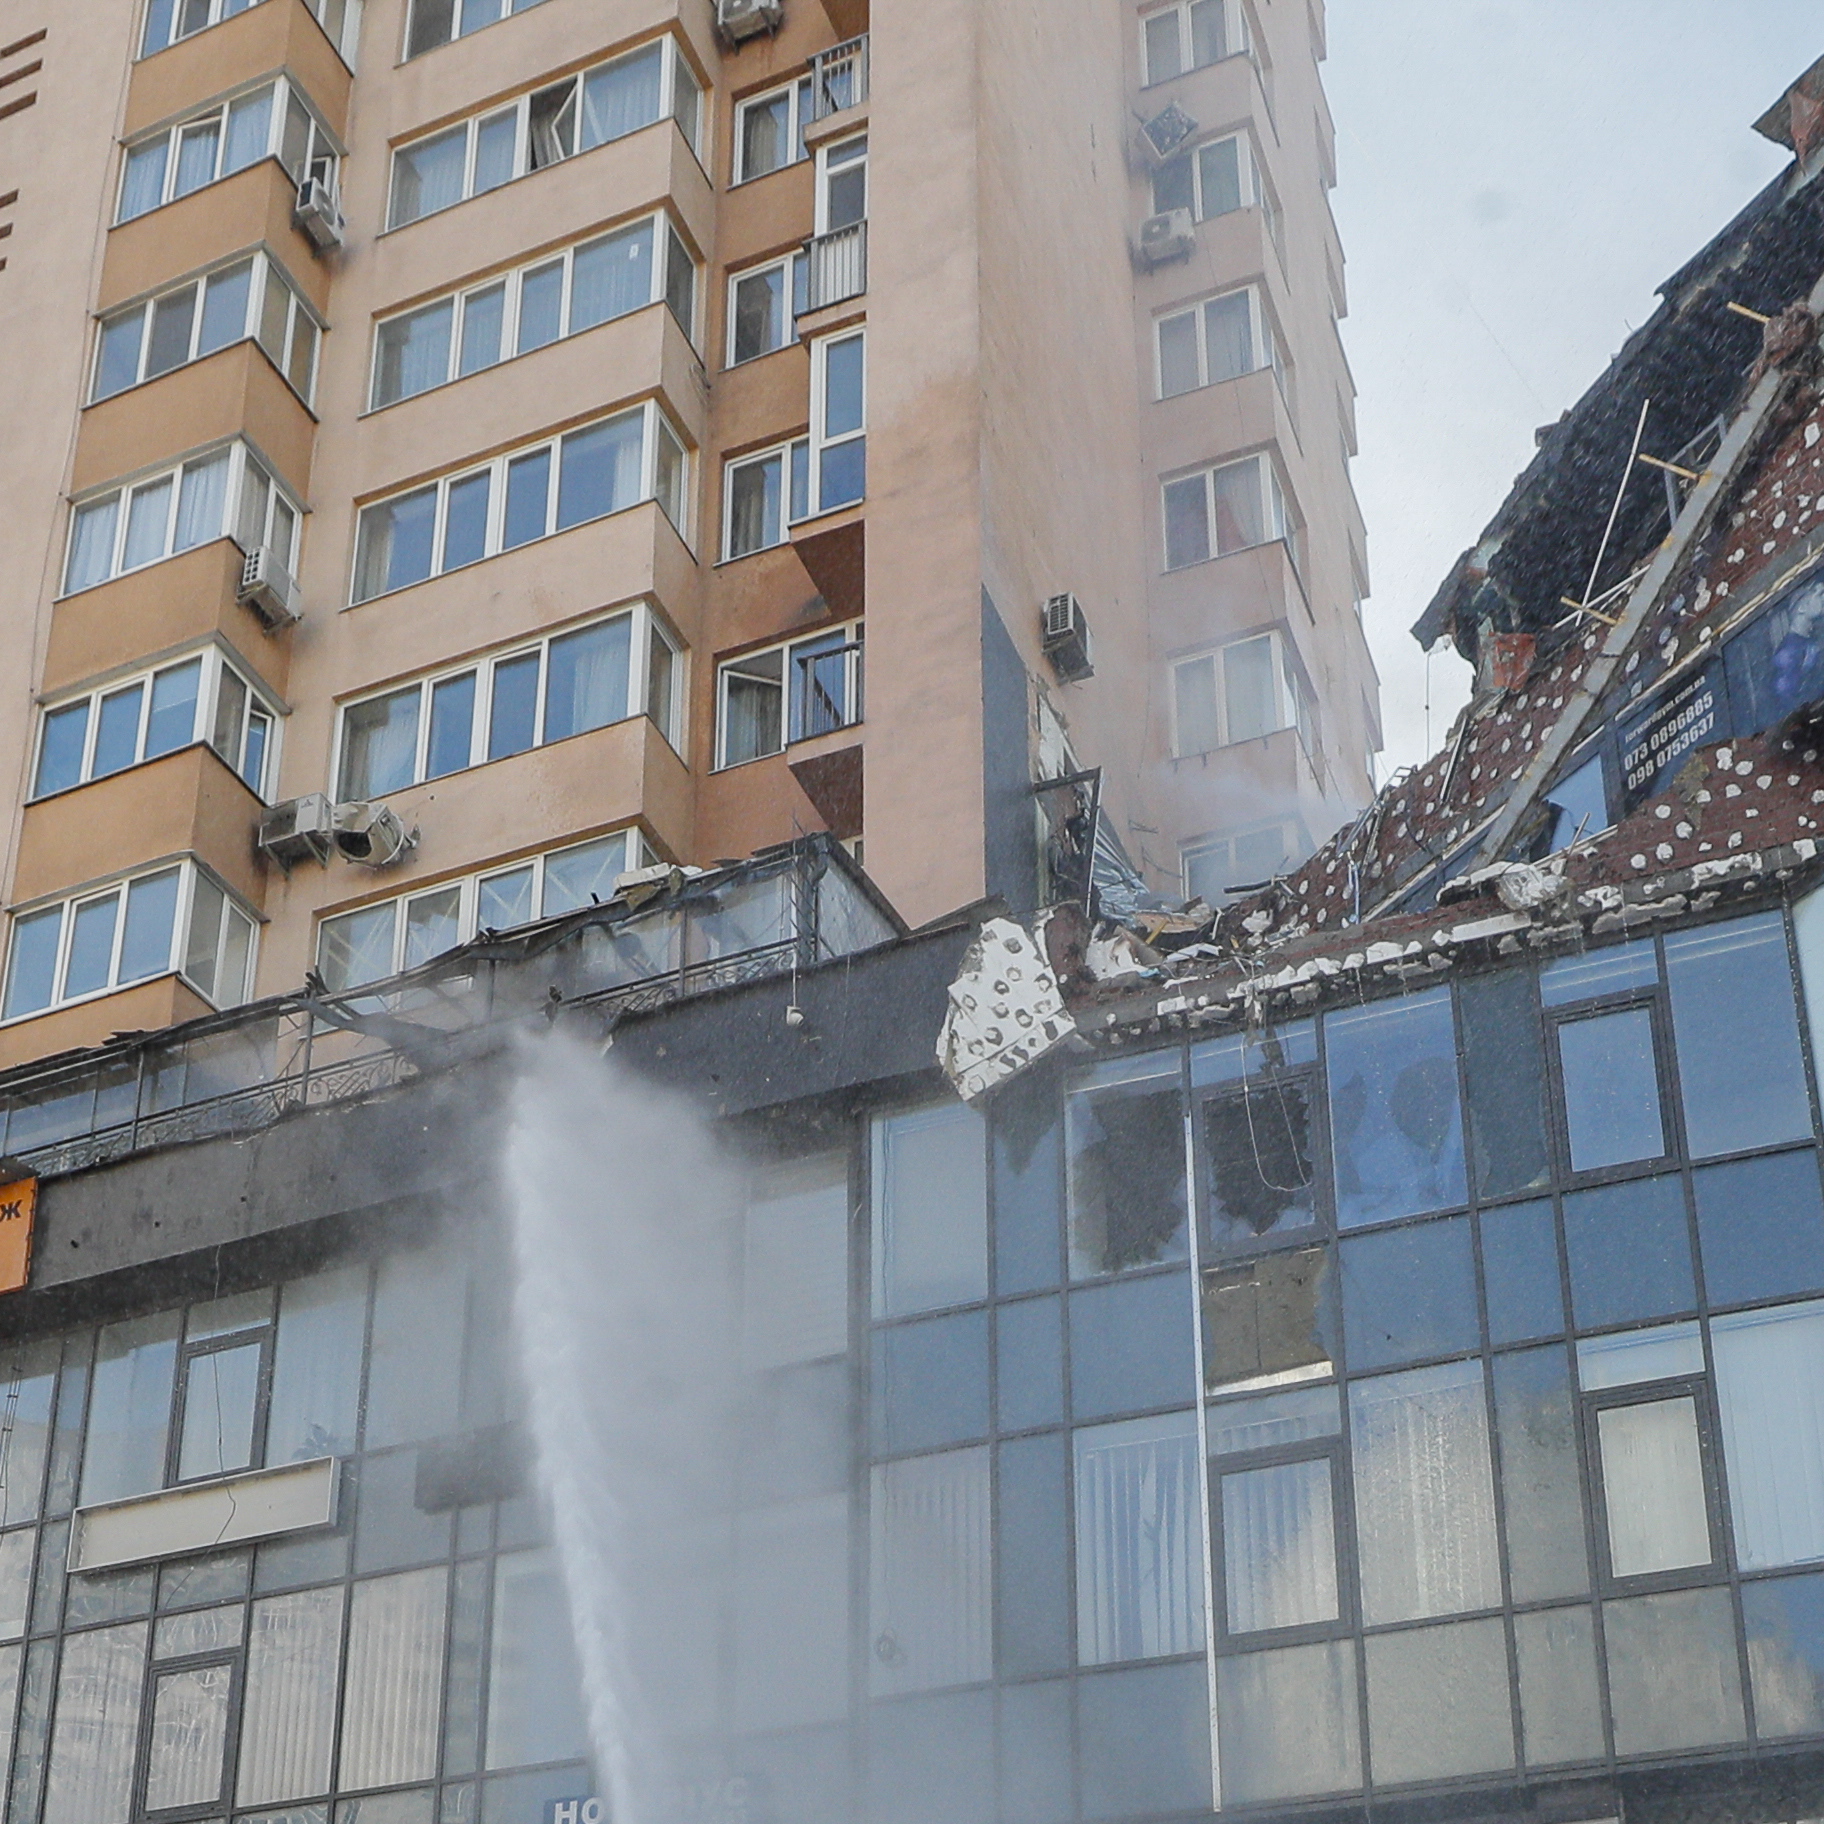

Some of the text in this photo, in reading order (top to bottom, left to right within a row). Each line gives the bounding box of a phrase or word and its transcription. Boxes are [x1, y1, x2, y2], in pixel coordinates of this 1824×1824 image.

[1624, 690, 1714, 771] 073 0896885
[1627, 712, 1716, 790] 098 0753637
